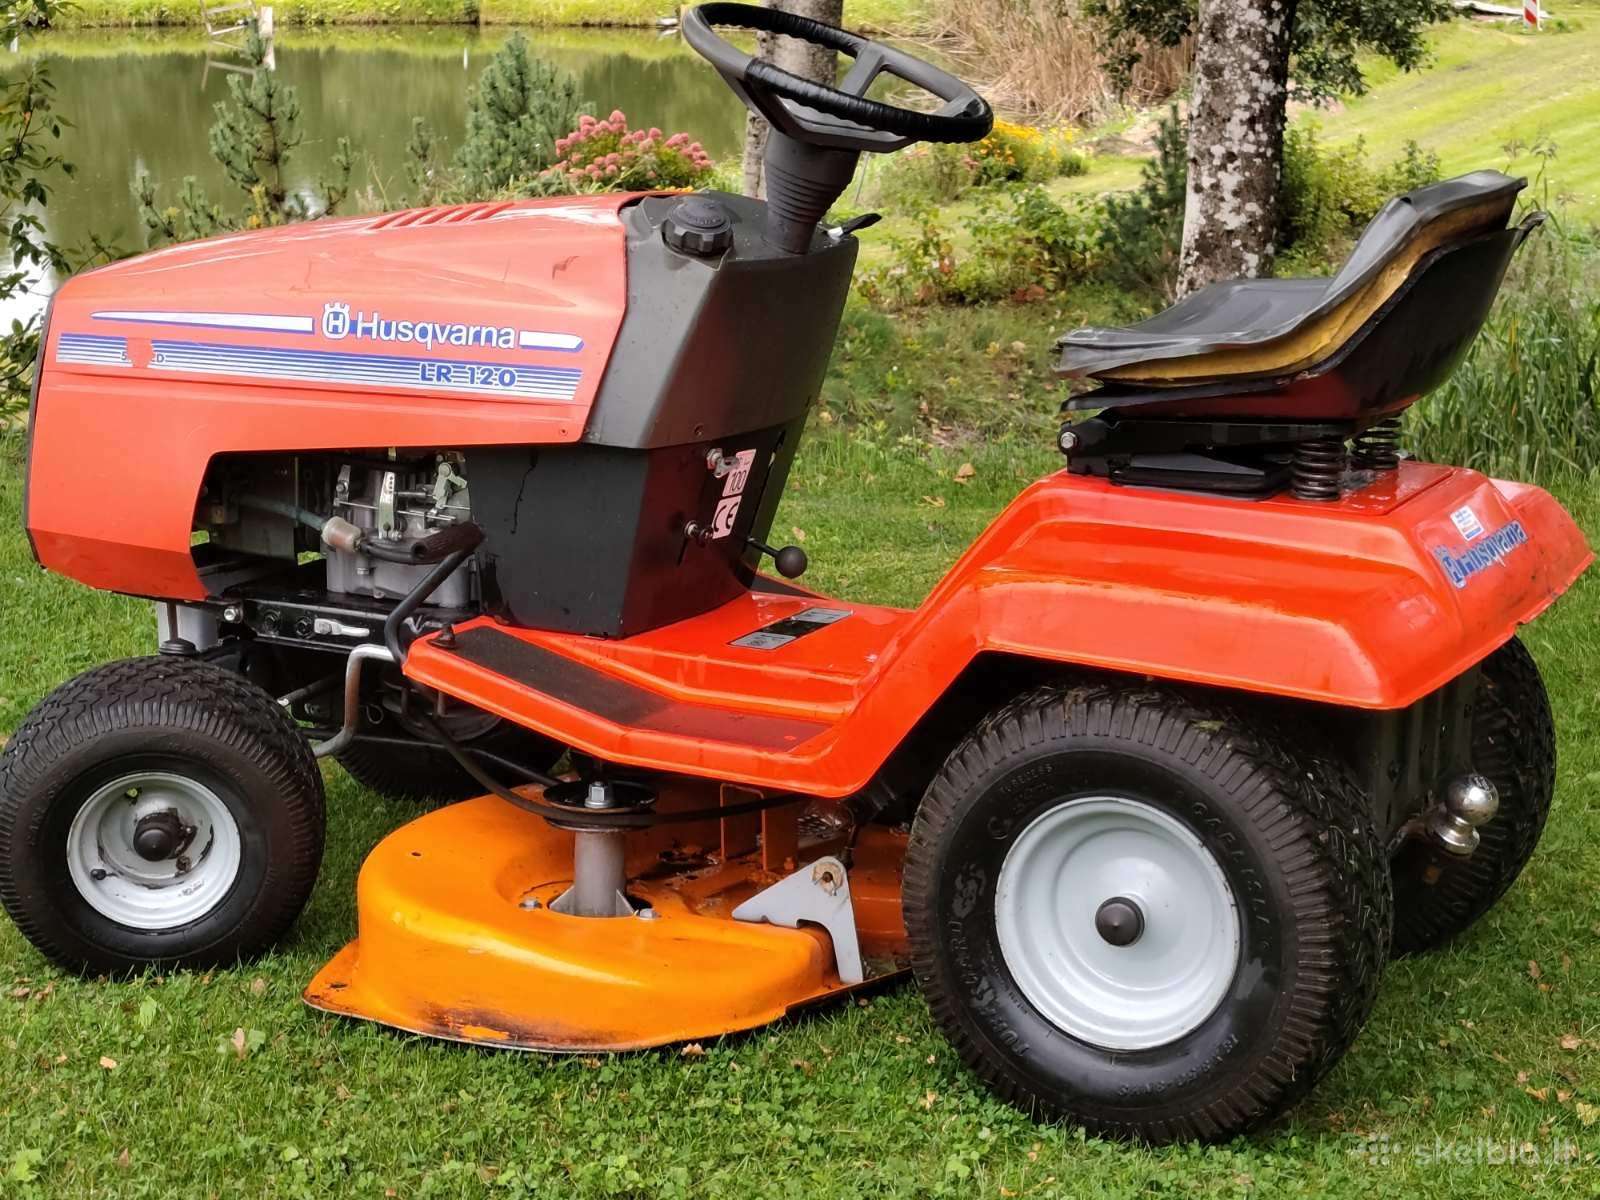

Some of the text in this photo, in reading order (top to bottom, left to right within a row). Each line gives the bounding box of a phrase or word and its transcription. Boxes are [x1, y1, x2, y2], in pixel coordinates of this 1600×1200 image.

[356, 311, 516, 351] Husqvarna
[419, 363, 516, 387] LR 120
